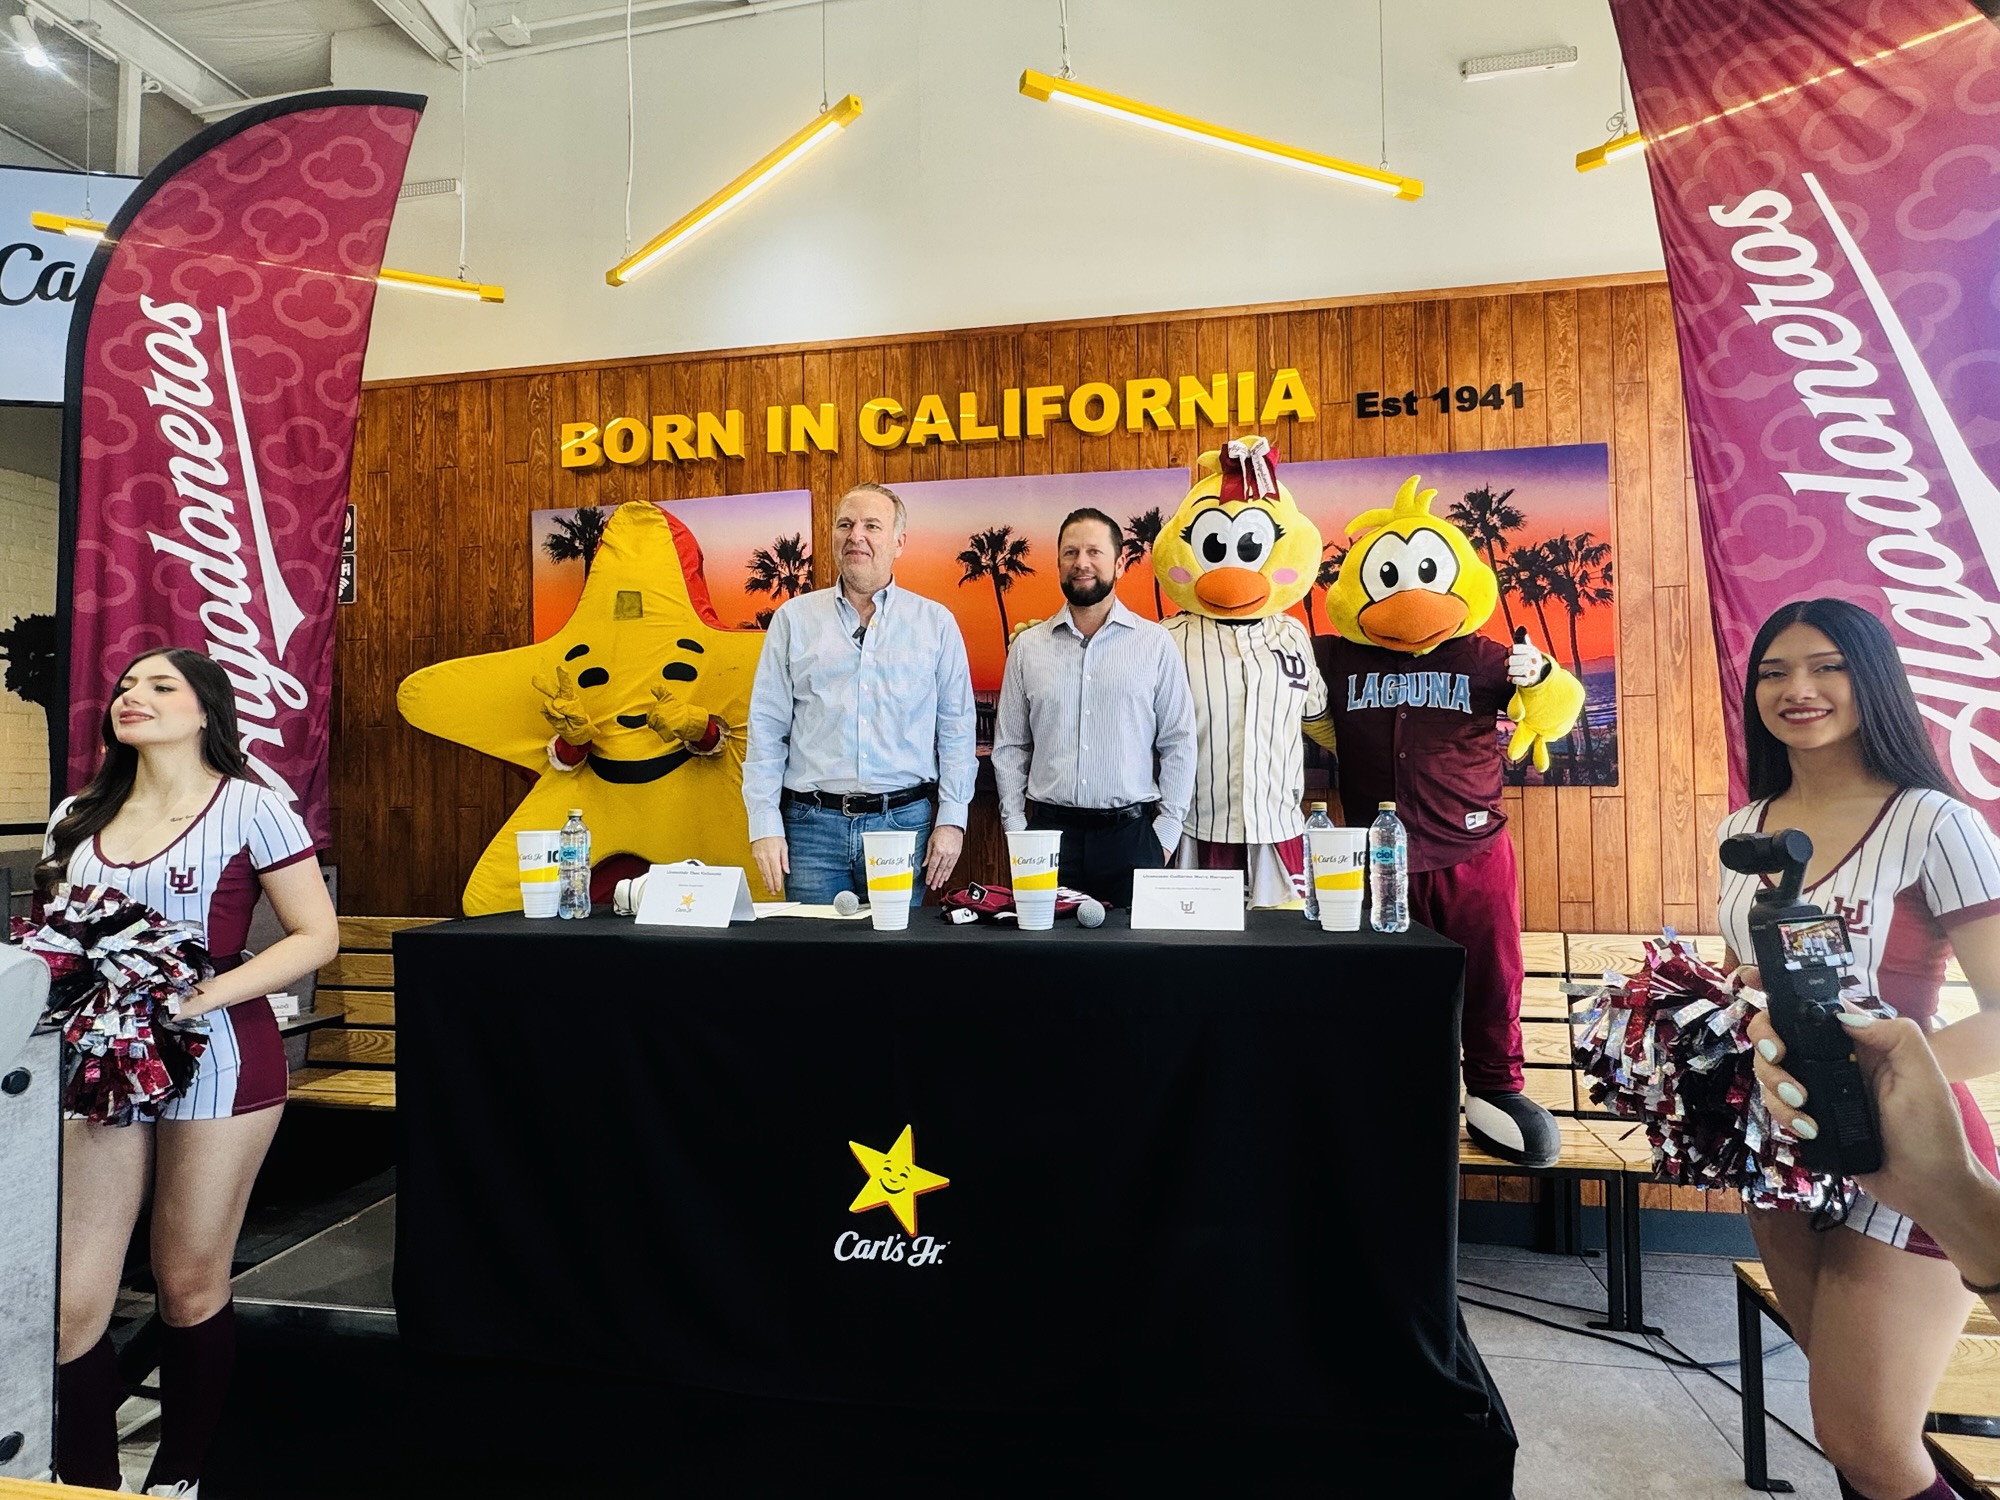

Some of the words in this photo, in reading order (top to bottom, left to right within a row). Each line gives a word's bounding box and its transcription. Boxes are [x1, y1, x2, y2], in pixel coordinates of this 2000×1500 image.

[1356, 391, 1418, 418] Est
[1433, 382, 1524, 413] 1941
[560, 409, 744, 470] BORN
[767, 402, 838, 457] IN
[859, 368, 1316, 450] CALIFORNIA
[1347, 672, 1472, 714] LAGUNA
[1375, 849, 1394, 859] ciel
[834, 1231, 906, 1262] Carl's
[907, 1236, 946, 1267] Jr.
